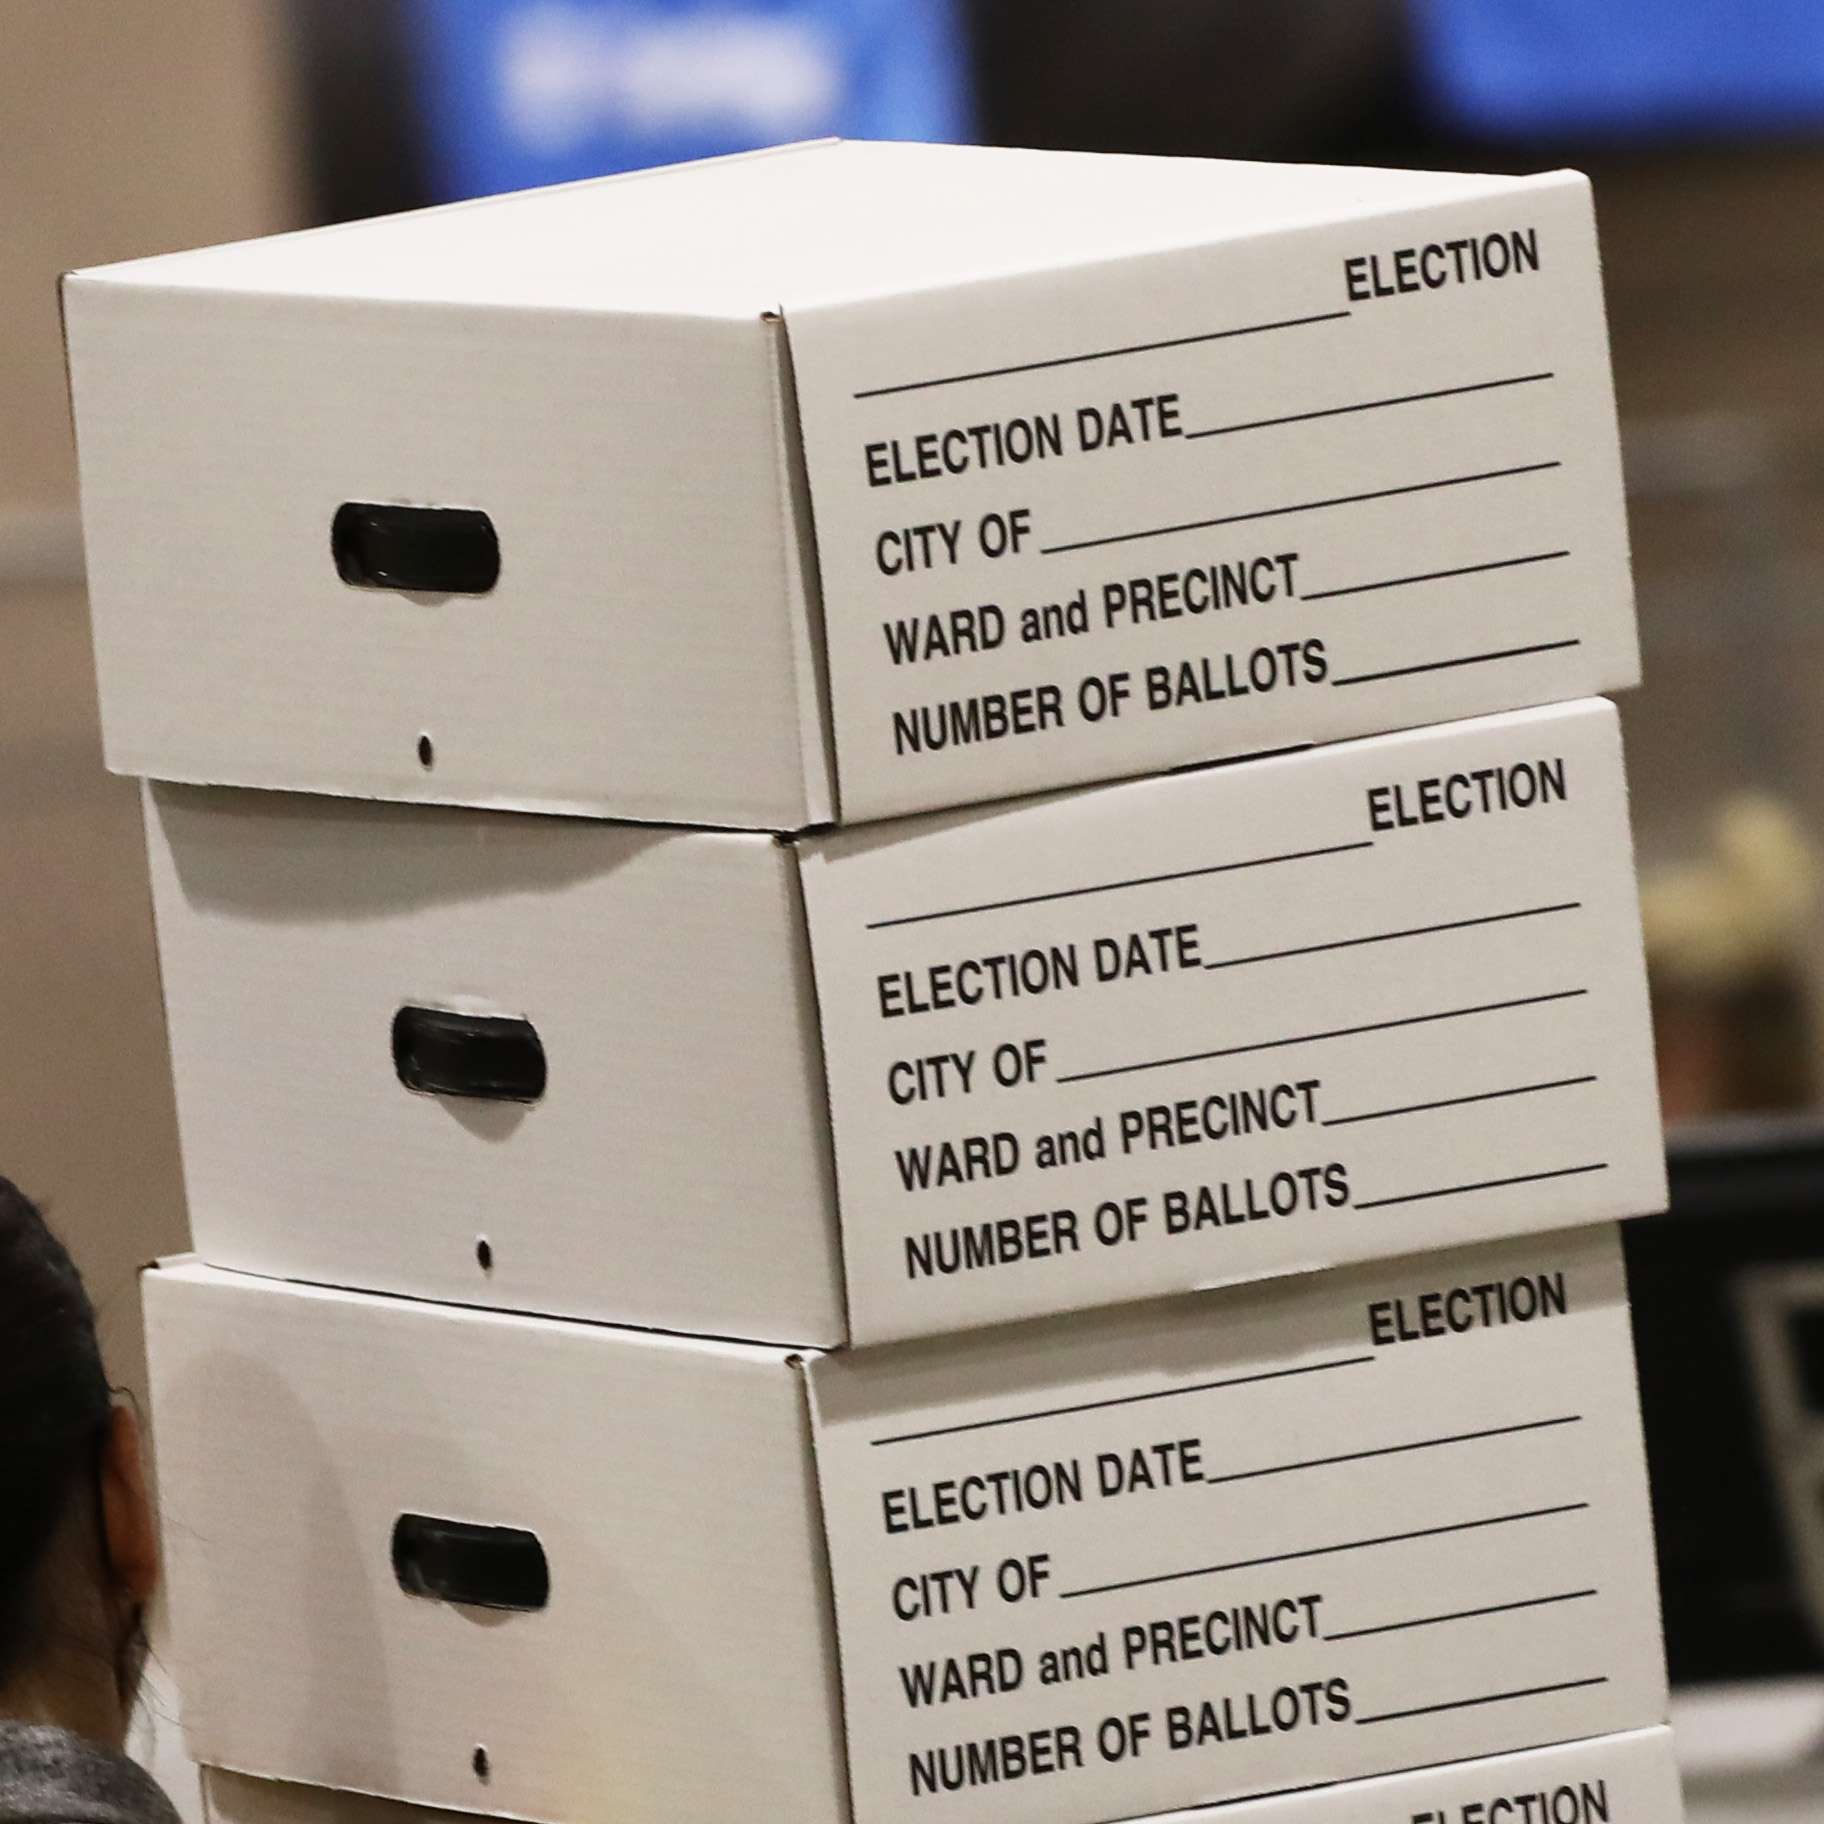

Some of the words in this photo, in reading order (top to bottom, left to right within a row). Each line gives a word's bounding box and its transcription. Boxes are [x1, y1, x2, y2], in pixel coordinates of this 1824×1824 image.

[1344, 228, 1539, 302] ELECTION
[865, 413, 1063, 488] ELECTION
[1076, 393, 1183, 452] DATE
[876, 520, 961, 576] CITY
[979, 508, 1031, 559] OF
[883, 604, 1005, 665] WARD
[1021, 589, 1089, 643] and
[1103, 552, 1299, 629] PRECINCT
[893, 684, 1065, 756] NUMBER
[1078, 672, 1130, 722] OF
[1145, 638, 1328, 711] BALLOTS
[1367, 758, 1567, 832] ELECTION
[877, 944, 1079, 1019] ELECTION
[1093, 923, 1202, 983] DATE
[888, 1050, 976, 1106] CITY
[993, 1038, 1046, 1088] OF
[894, 1132, 1020, 1192] WARD
[1035, 1116, 1106, 1169] and
[1120, 1079, 1320, 1154] PRECINCT
[905, 1209, 1080, 1279] NUMBER
[1094, 1197, 1148, 1247] OF
[1163, 1162, 1349, 1235] BALLOTS
[1366, 1269, 1568, 1346] ELECTION
[882, 1459, 1083, 1535] ELECTION
[1096, 1438, 1205, 1498] DATE
[892, 1565, 979, 1622] CITY
[997, 1553, 1050, 1603] OF
[899, 1648, 1024, 1708] WARD
[1039, 1631, 1109, 1685] and
[1123, 1594, 1322, 1670] PRECINCT
[909, 1725, 1084, 1797] NUMBER
[1097, 1712, 1150, 1763] OF
[1166, 1677, 1351, 1750] BALLOTS
